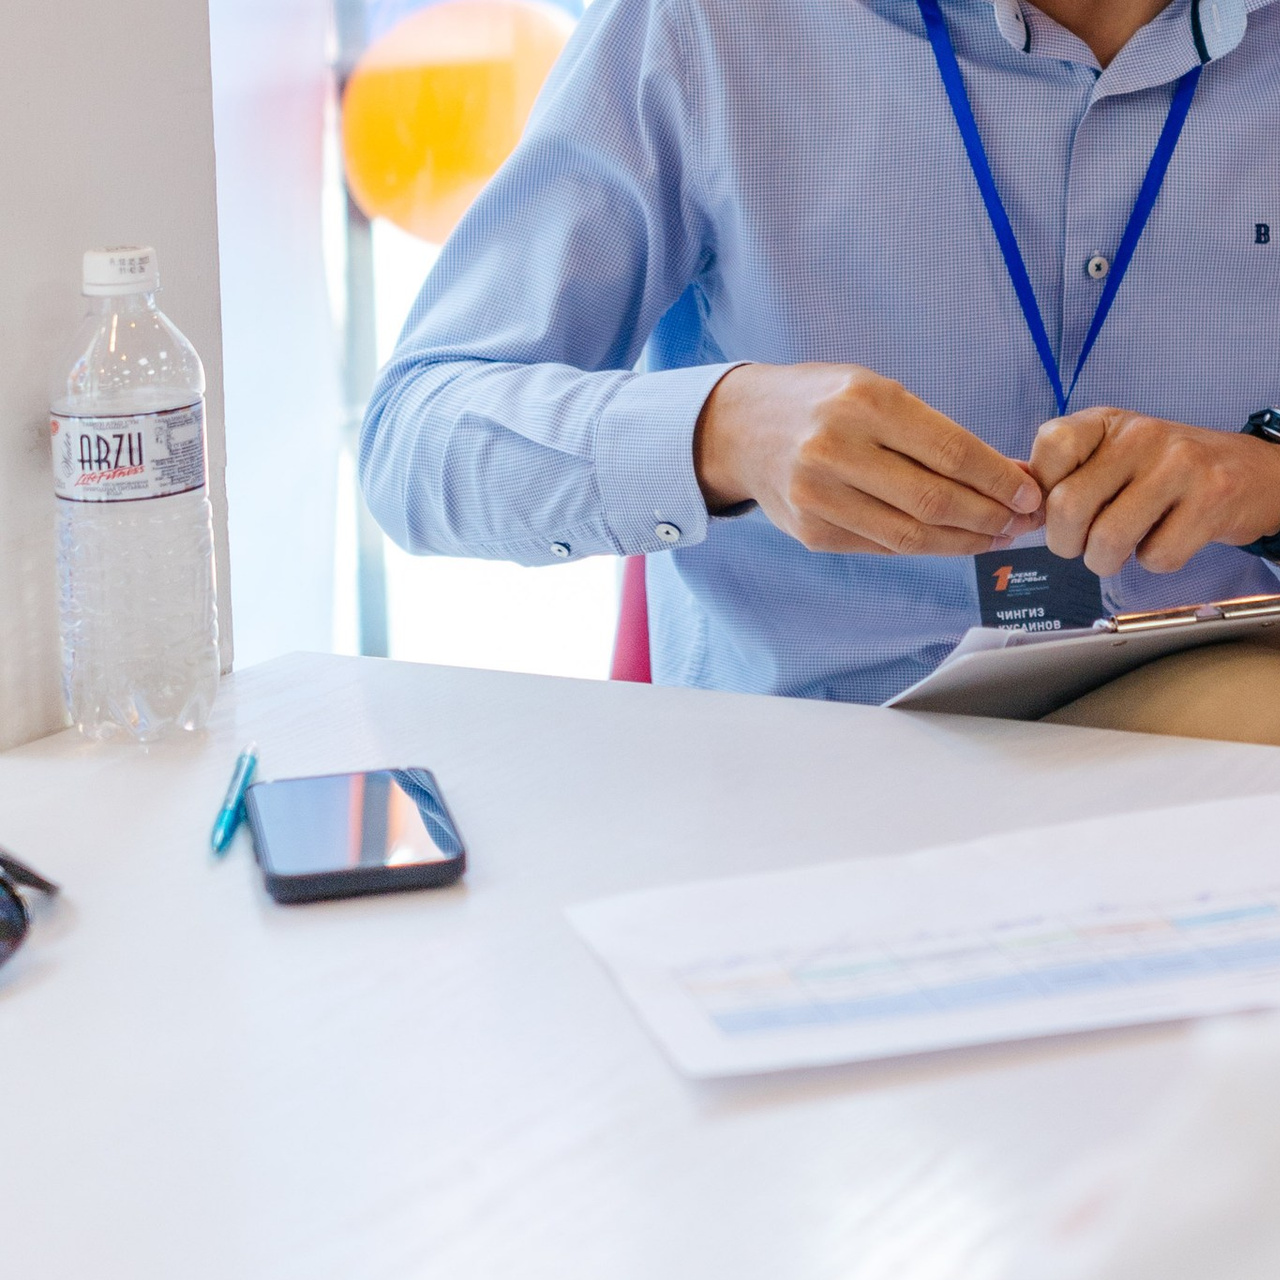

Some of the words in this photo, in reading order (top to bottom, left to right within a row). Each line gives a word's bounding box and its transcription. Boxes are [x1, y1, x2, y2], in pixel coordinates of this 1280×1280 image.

[1254, 223, 1270, 244] B
[77, 432, 143, 471] ARZU
[996, 607, 1045, 621] ЧИНГИЗ
